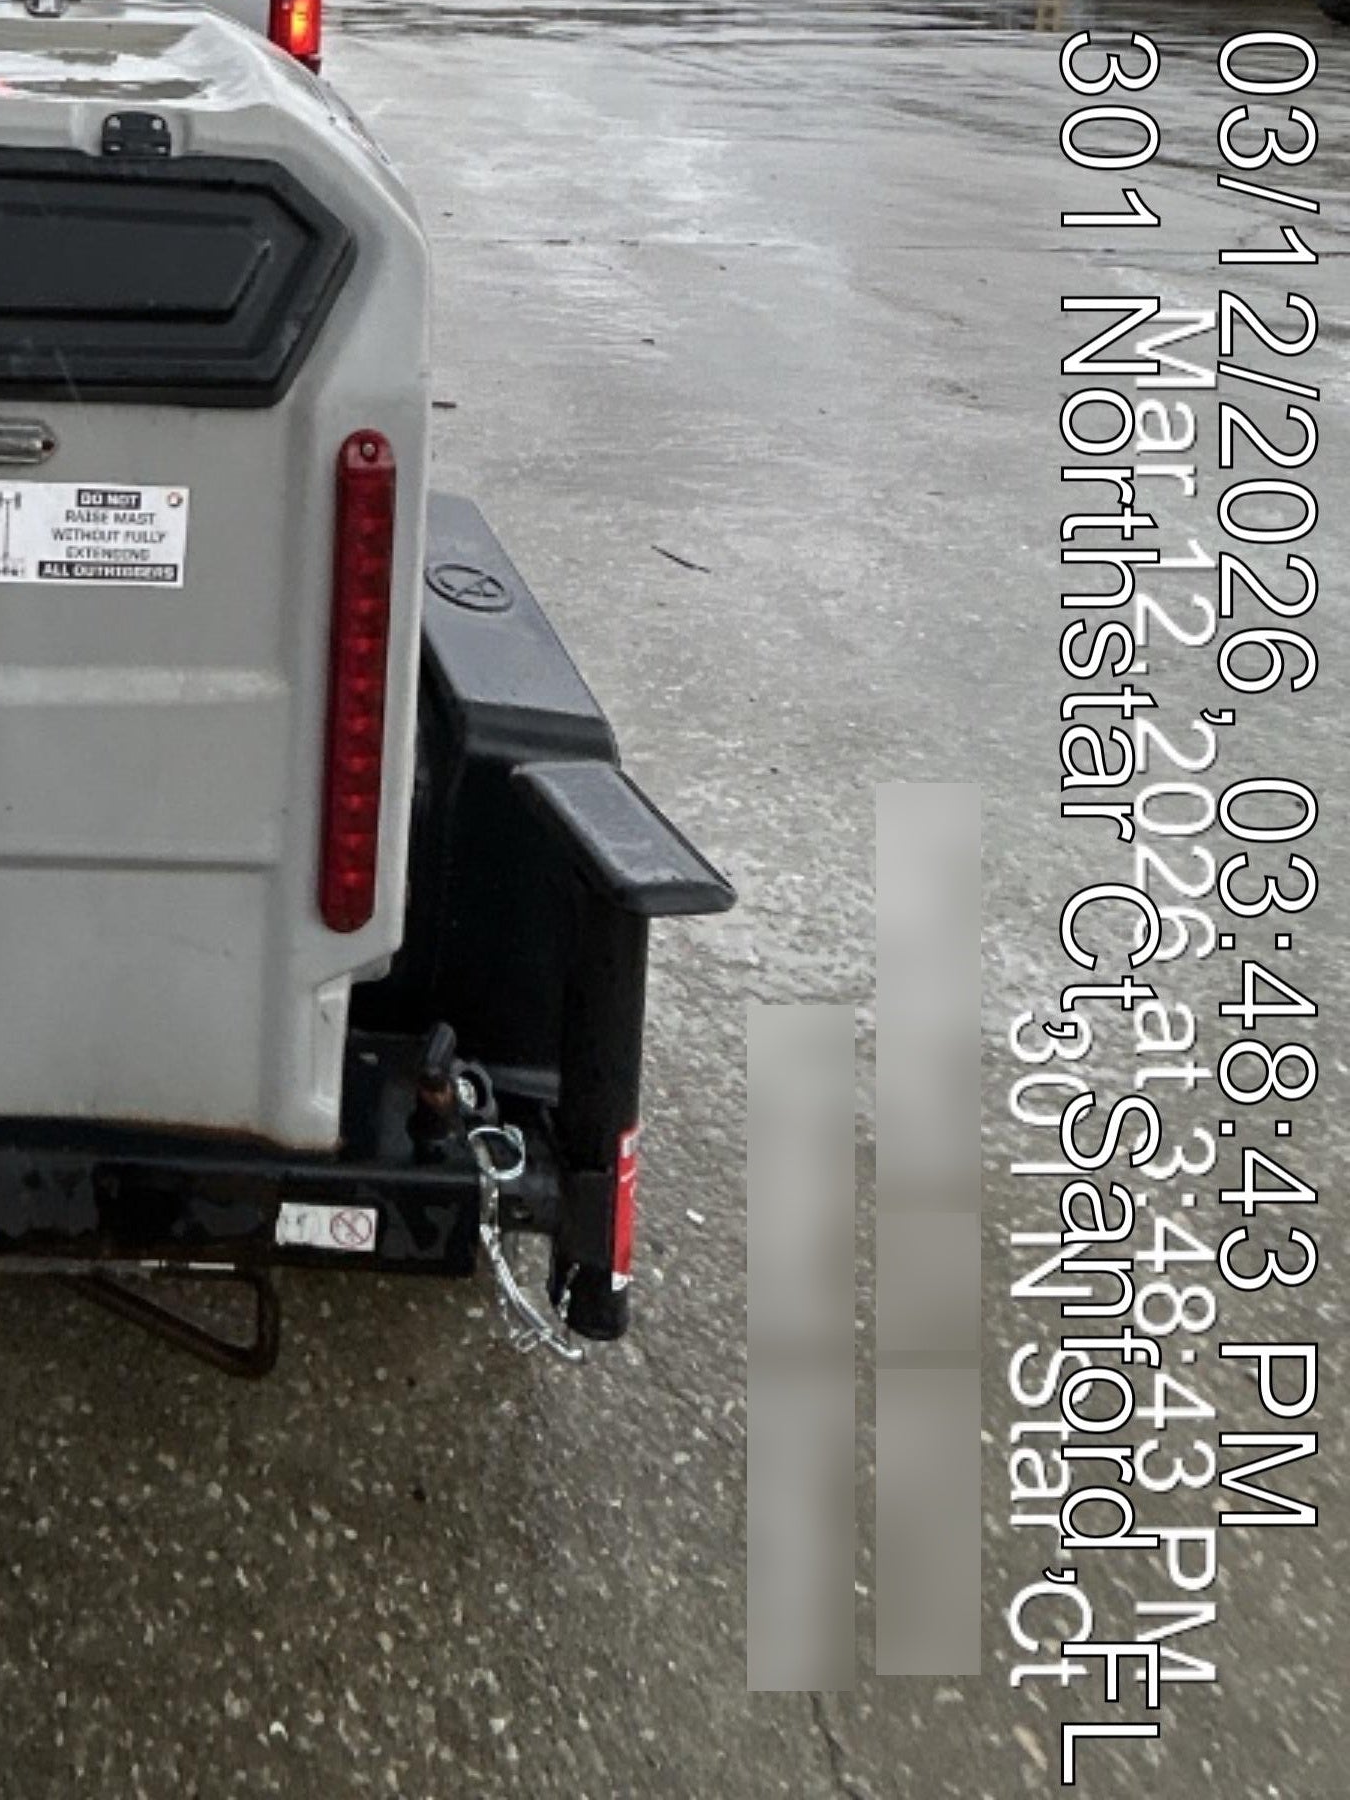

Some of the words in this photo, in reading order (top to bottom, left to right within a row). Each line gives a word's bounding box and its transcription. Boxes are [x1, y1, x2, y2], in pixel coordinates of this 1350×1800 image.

[80, 492, 101, 506] DO
[107, 493, 139, 507] NOT
[113, 512, 156, 526] MAST
[52, 527, 120, 543] WITHOUT
[124, 530, 167, 545] FULLY
[43, 563, 71, 577] ALL
